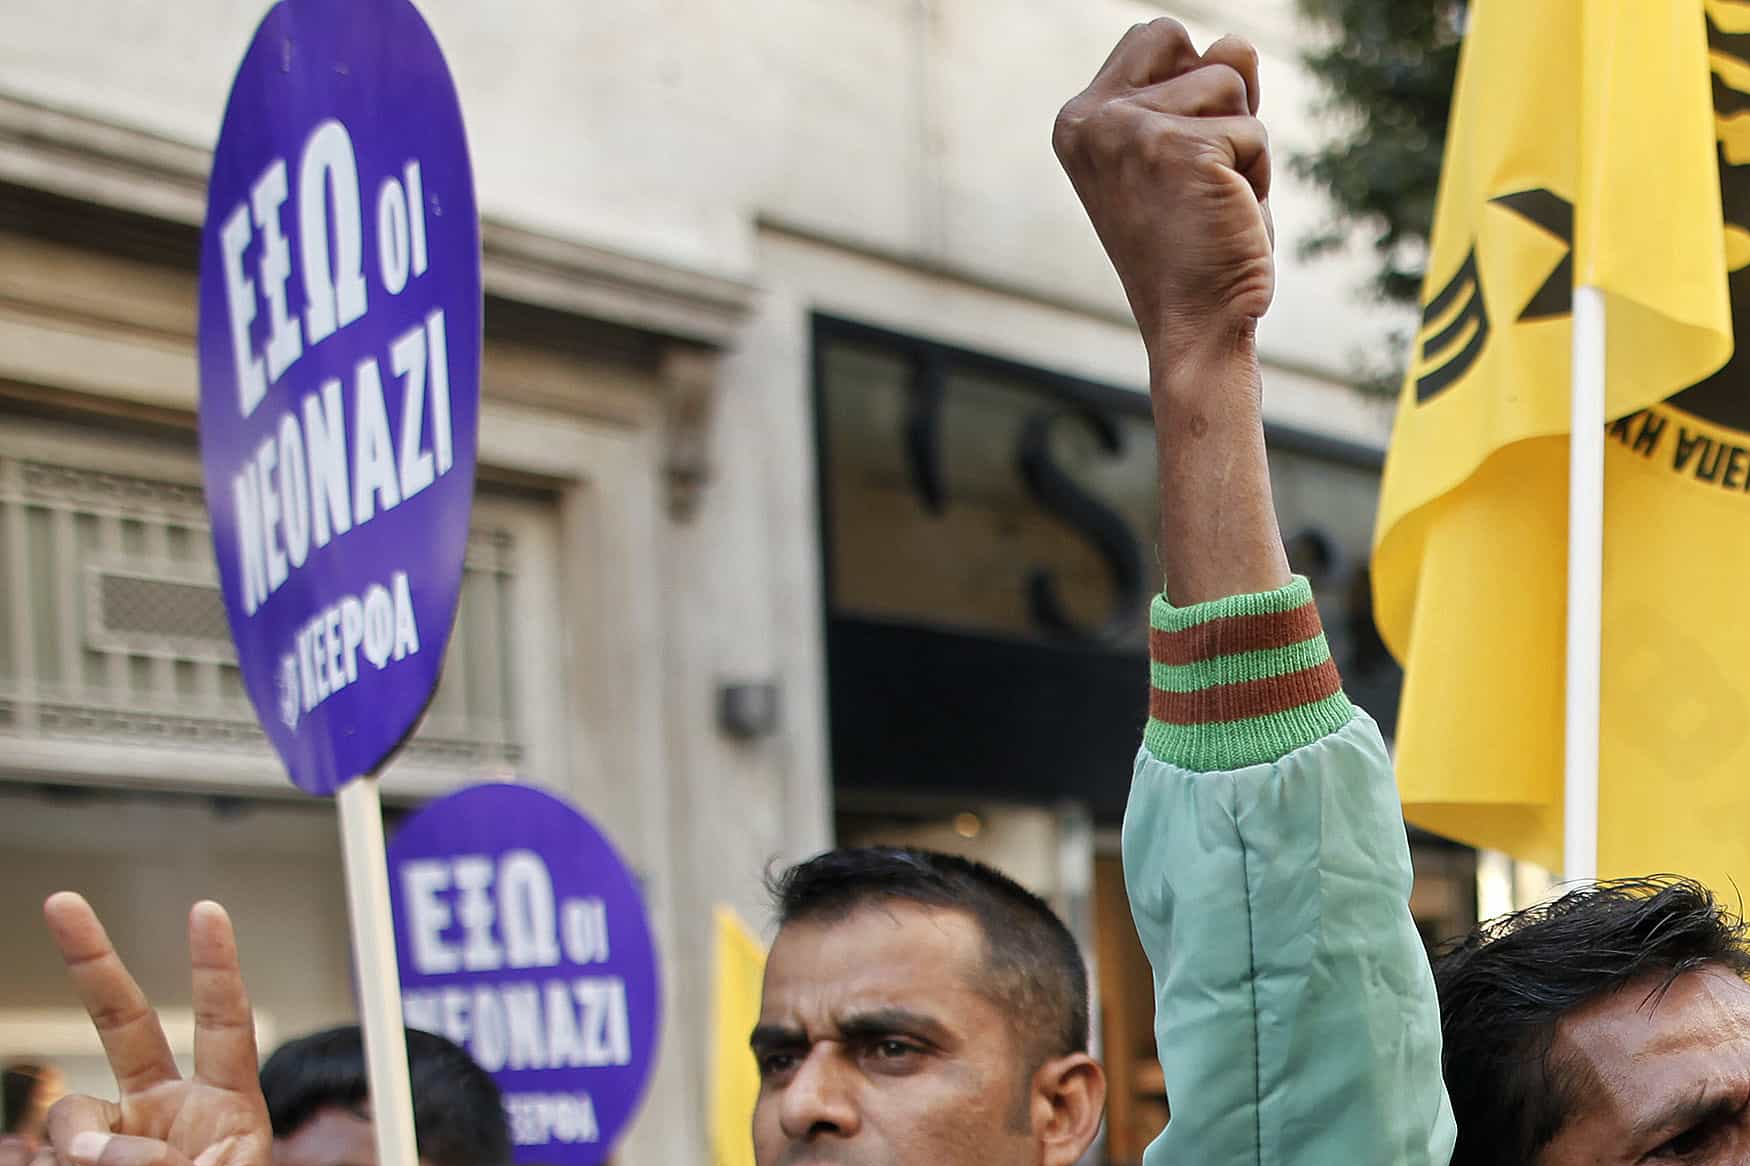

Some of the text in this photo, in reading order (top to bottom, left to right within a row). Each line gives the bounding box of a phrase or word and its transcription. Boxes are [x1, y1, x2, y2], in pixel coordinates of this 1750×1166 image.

[220, 116, 429, 420] ΕΞΩ ΟΙ
[233, 309, 455, 618] ΝΕΟΝΑΖΙ
[298, 570, 420, 714] ΚΕΕΡΦΑ
[404, 848, 609, 975] ΕΞΩ ΟΙ
